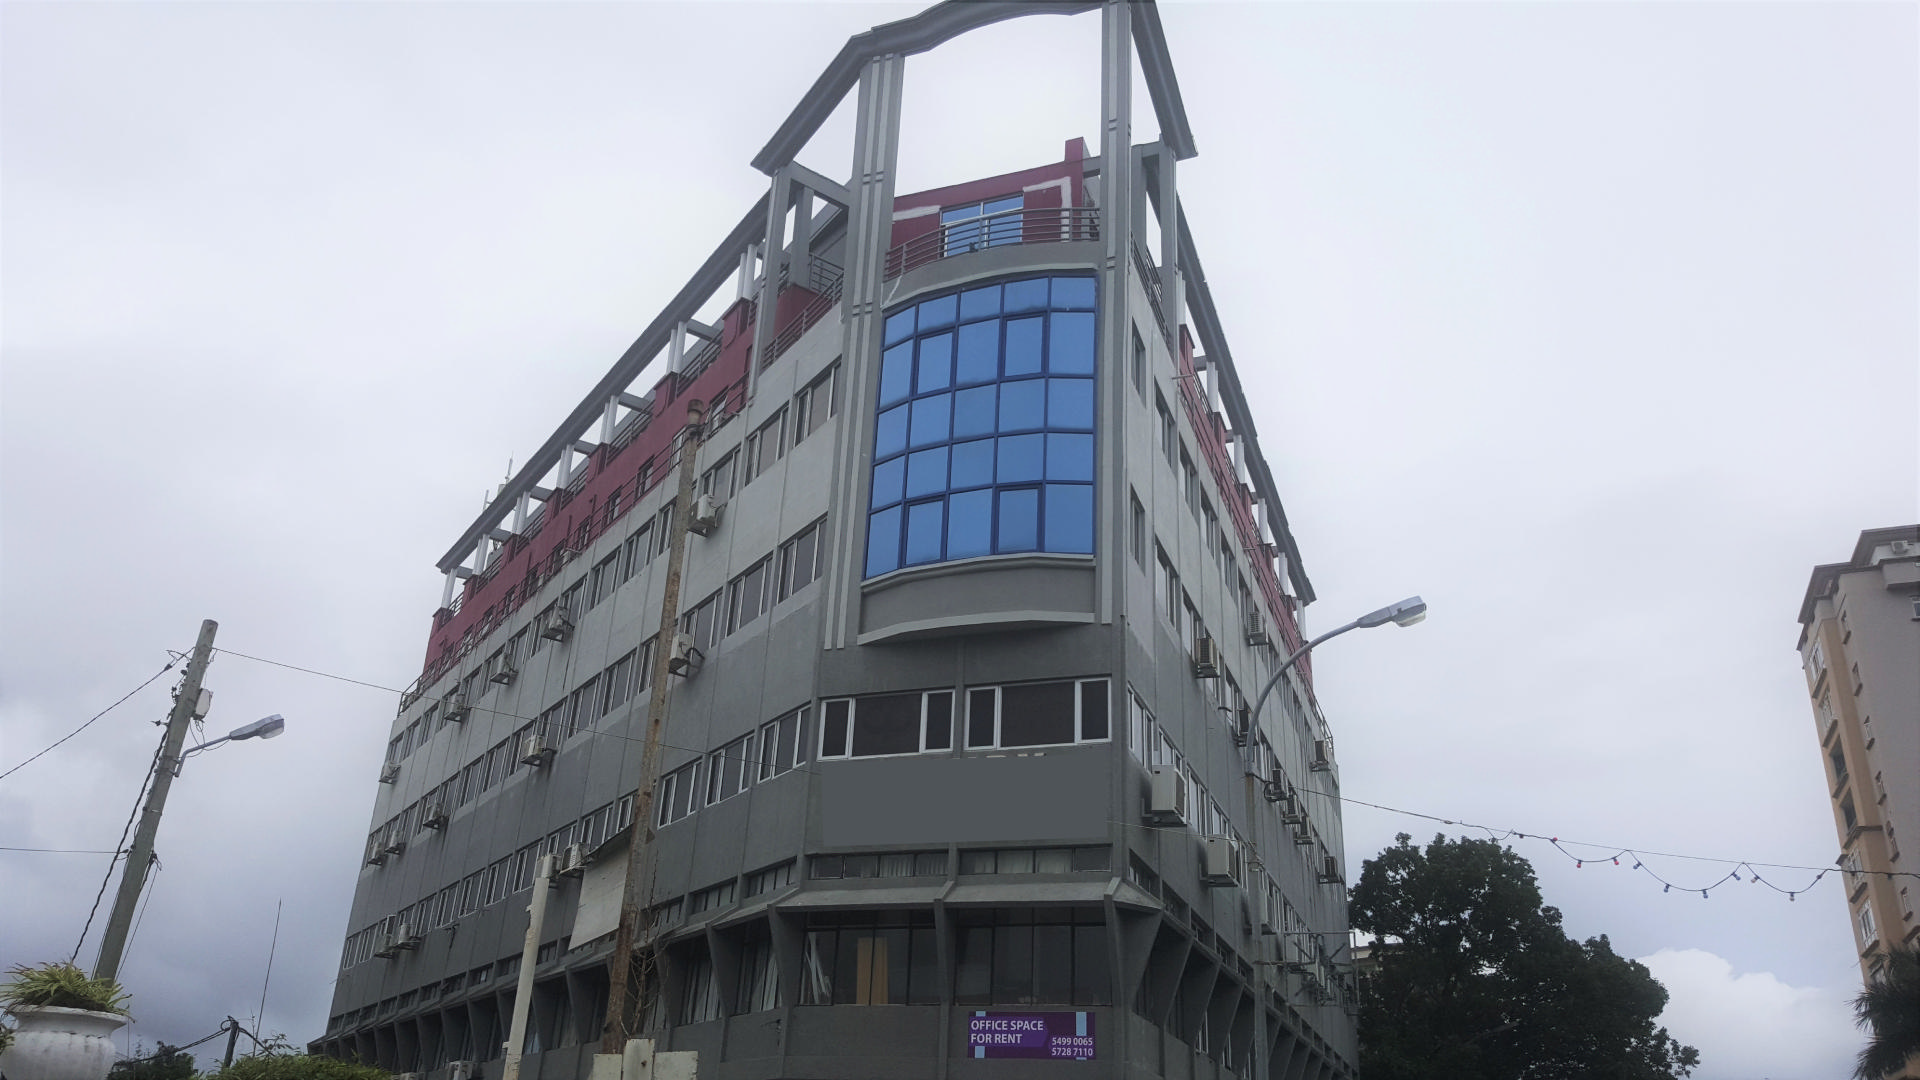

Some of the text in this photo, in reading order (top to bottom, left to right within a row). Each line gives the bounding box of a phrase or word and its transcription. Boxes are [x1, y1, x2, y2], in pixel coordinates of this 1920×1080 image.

[971, 1020, 1044, 1031] OFFICE SPACE
[970, 1033, 1023, 1044] FOR RENT
[1052, 1037, 1093, 1046] 5499 0065
[1051, 1047, 1093, 1056] 5728 7110
